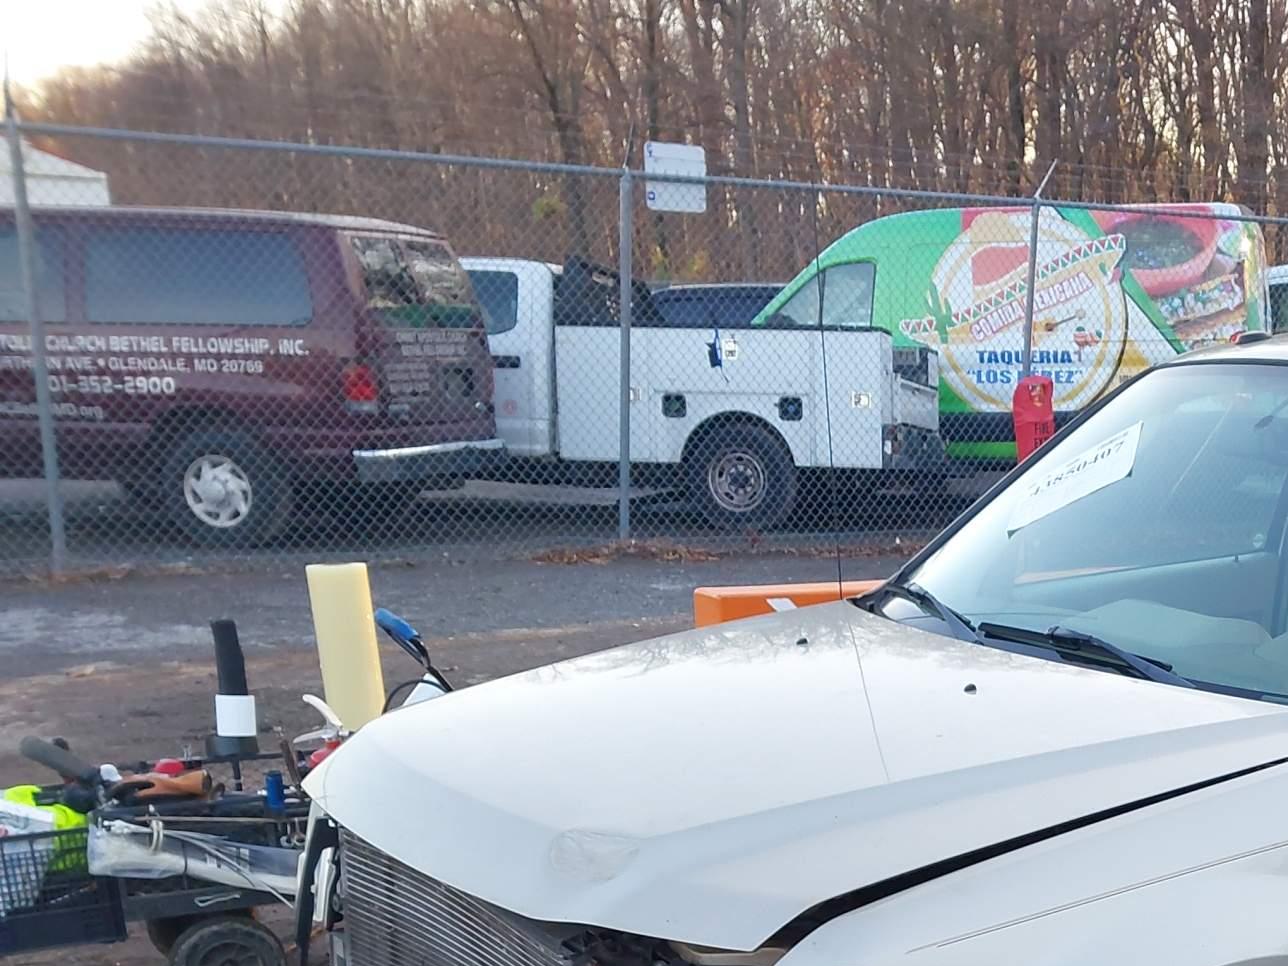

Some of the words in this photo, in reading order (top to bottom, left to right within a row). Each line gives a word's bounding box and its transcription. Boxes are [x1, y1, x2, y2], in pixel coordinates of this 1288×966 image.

[970, 299, 1025, 340] COMIDA
[108, 335, 169, 352] BETHEL
[194, 359, 218, 371] MD
[47, 374, 176, 394] 01-352-2900
